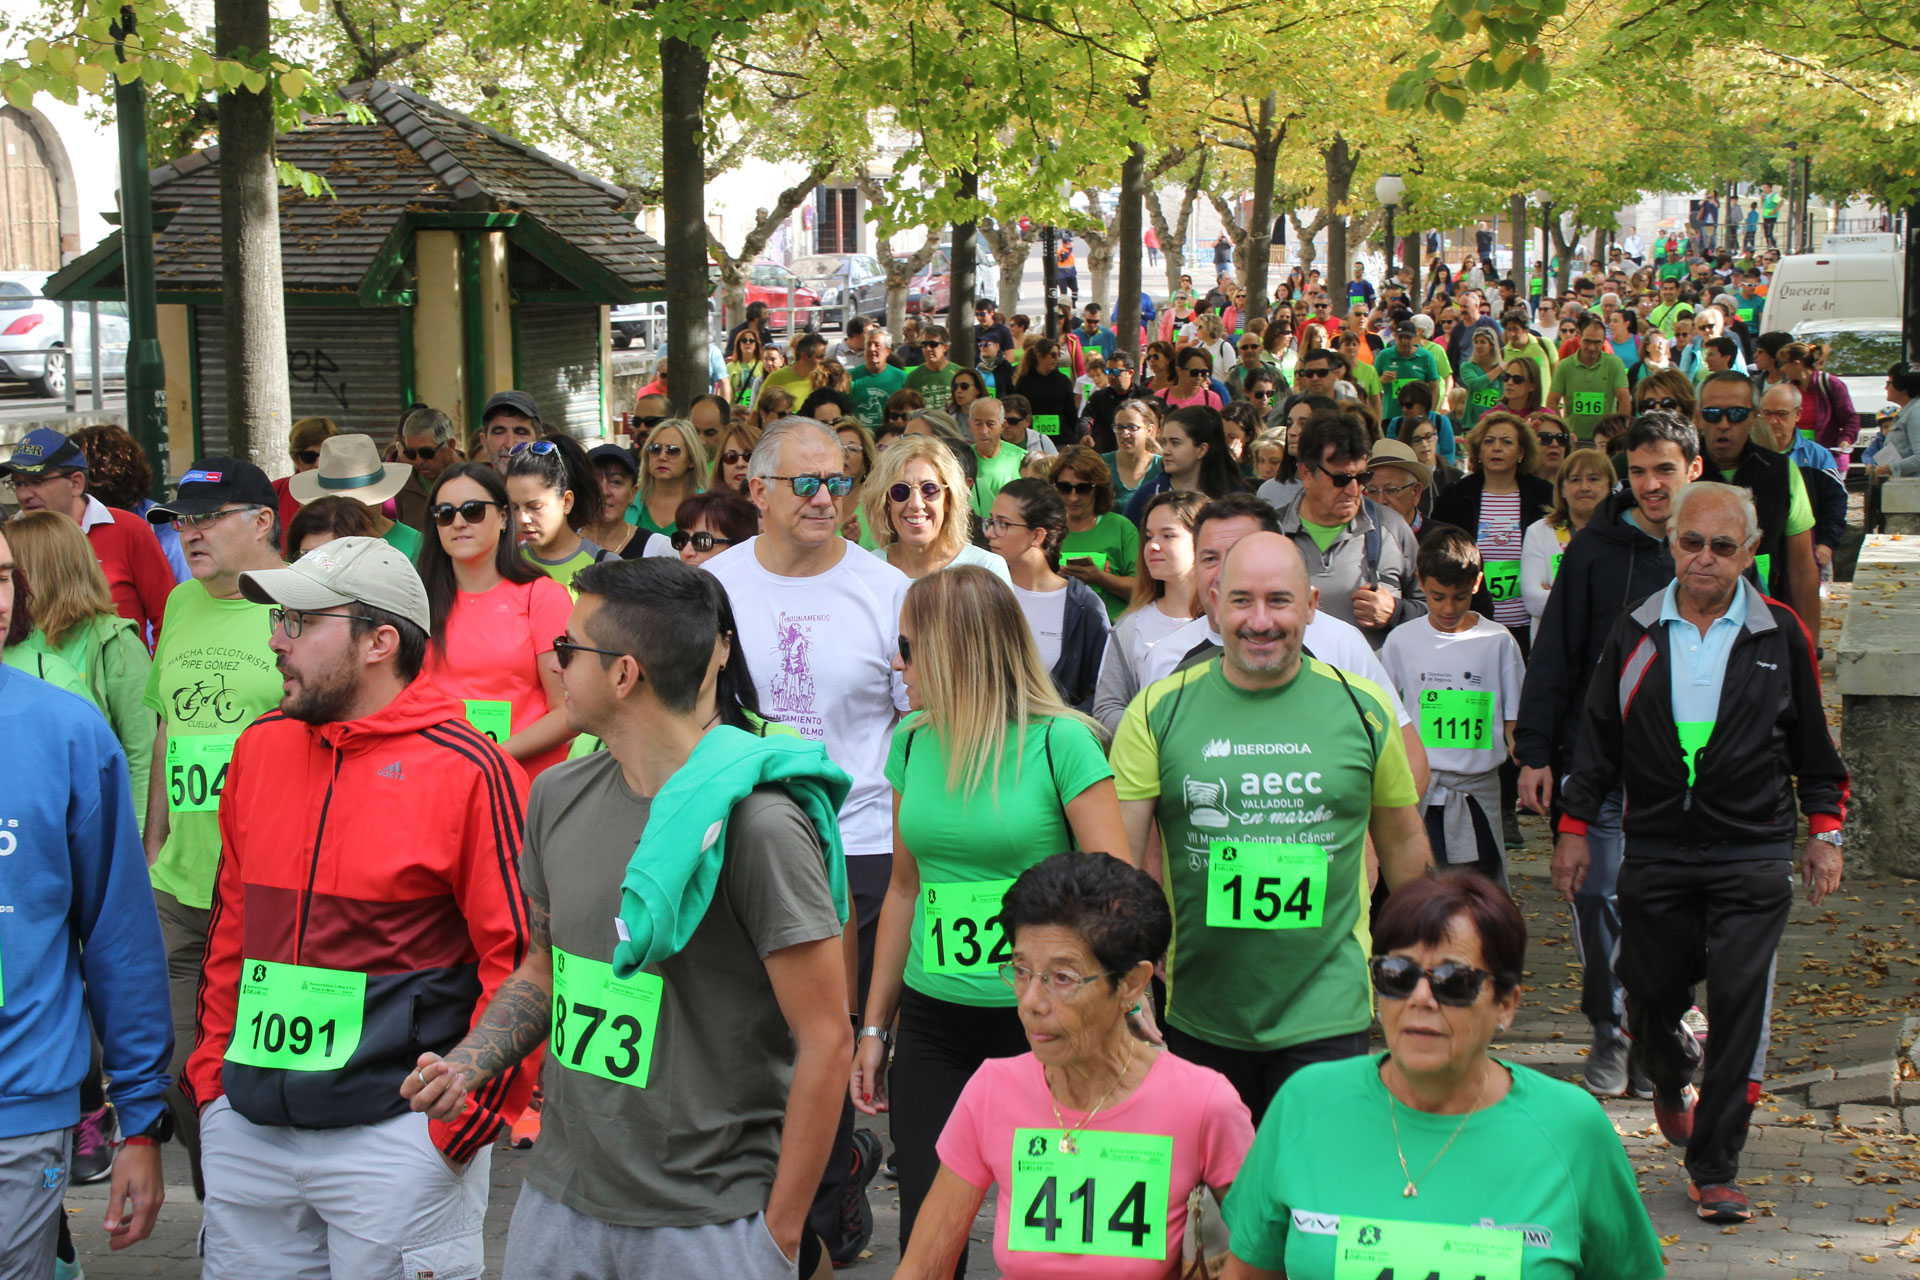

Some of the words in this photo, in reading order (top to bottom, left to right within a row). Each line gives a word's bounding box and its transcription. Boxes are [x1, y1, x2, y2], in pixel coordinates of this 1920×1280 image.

[1802, 300, 1816, 311] de
[1474, 393, 1498, 407] 915
[1575, 401, 1602, 414] 916
[1490, 575, 1518, 599] 57
[167, 648, 203, 667] MARCHA
[206, 647, 271, 673] CICLOTURISTA
[180, 659, 202, 670] PIPE
[204, 658, 240, 671] GÓMEZ
[187, 720, 218, 729] CUELLAR
[800, 727, 824, 737] OLMO
[1433, 717, 1484, 741] 1115
[1233, 743, 1312, 756] IBERDROLA
[1240, 771, 1323, 795] aecc
[1240, 812, 1265, 825] en
[1269, 803, 1335, 825] marcha
[1241, 798, 1304, 809] VALLADOLID
[1187, 831, 1198, 844] VII
[1286, 833, 1297, 844] el
[1299, 831, 1336, 844] Cáncer
[1222, 874, 1312, 922] 154
[930, 915, 1013, 967] 132
[251, 1010, 336, 1058] 1091
[555, 993, 643, 1078] 873
[1024, 1176, 1151, 1247] 414
